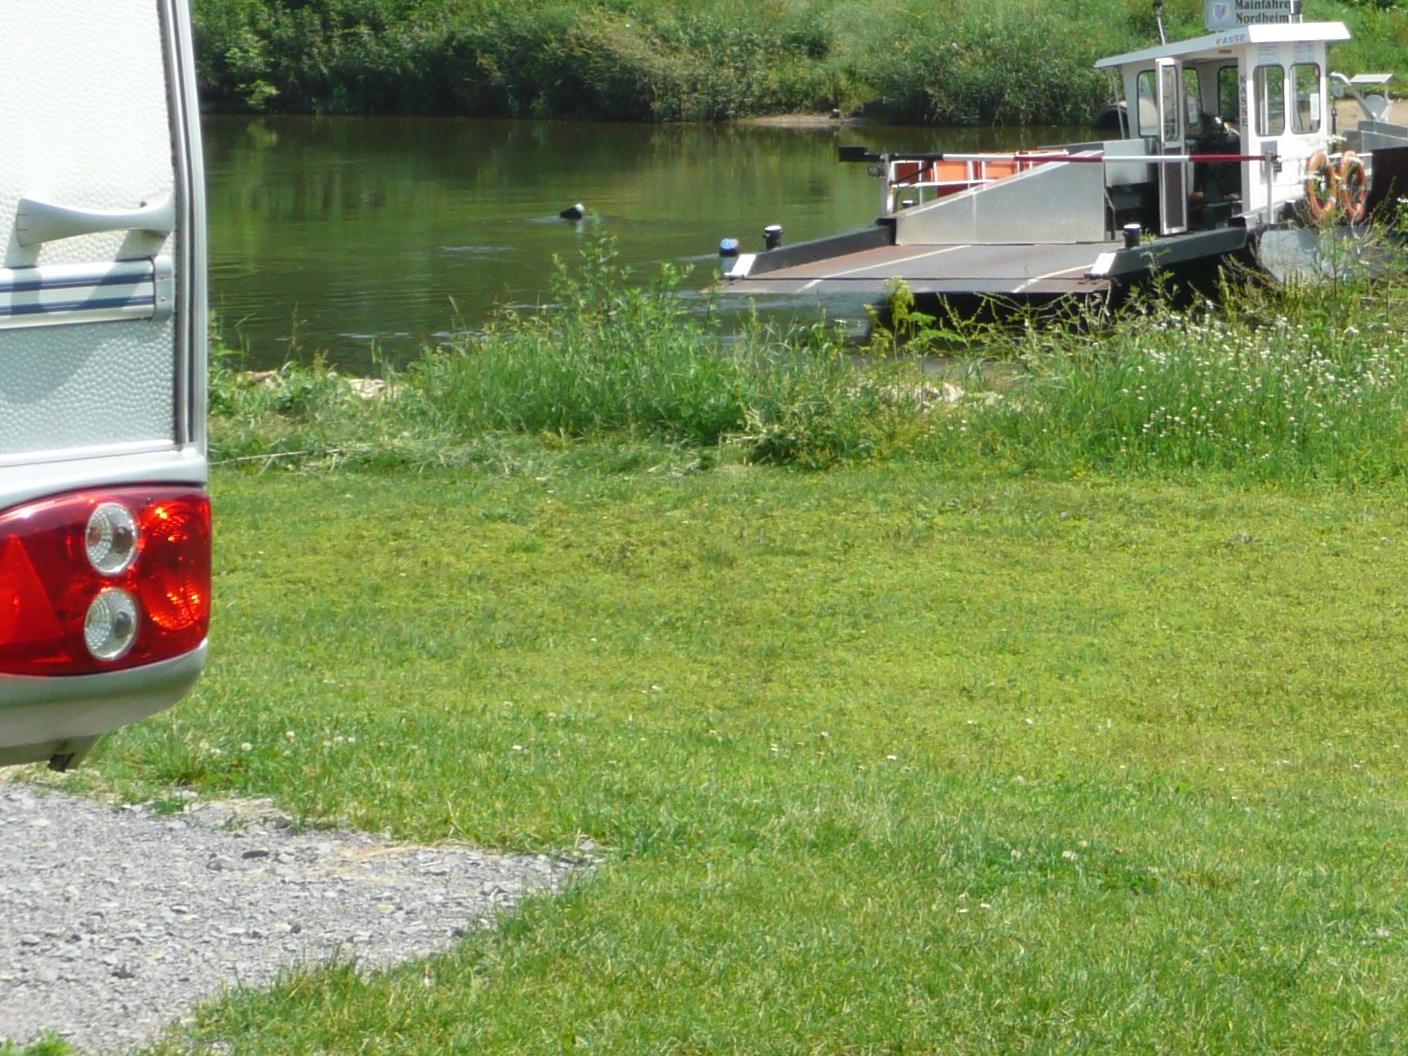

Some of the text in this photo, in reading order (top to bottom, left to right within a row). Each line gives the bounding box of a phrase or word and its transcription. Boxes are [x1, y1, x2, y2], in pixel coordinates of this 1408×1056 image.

[1236, 13, 1289, 24] Nordheim
[1216, 34, 1246, 45] KASSE
[1240, 75, 1248, 127] KASSE
